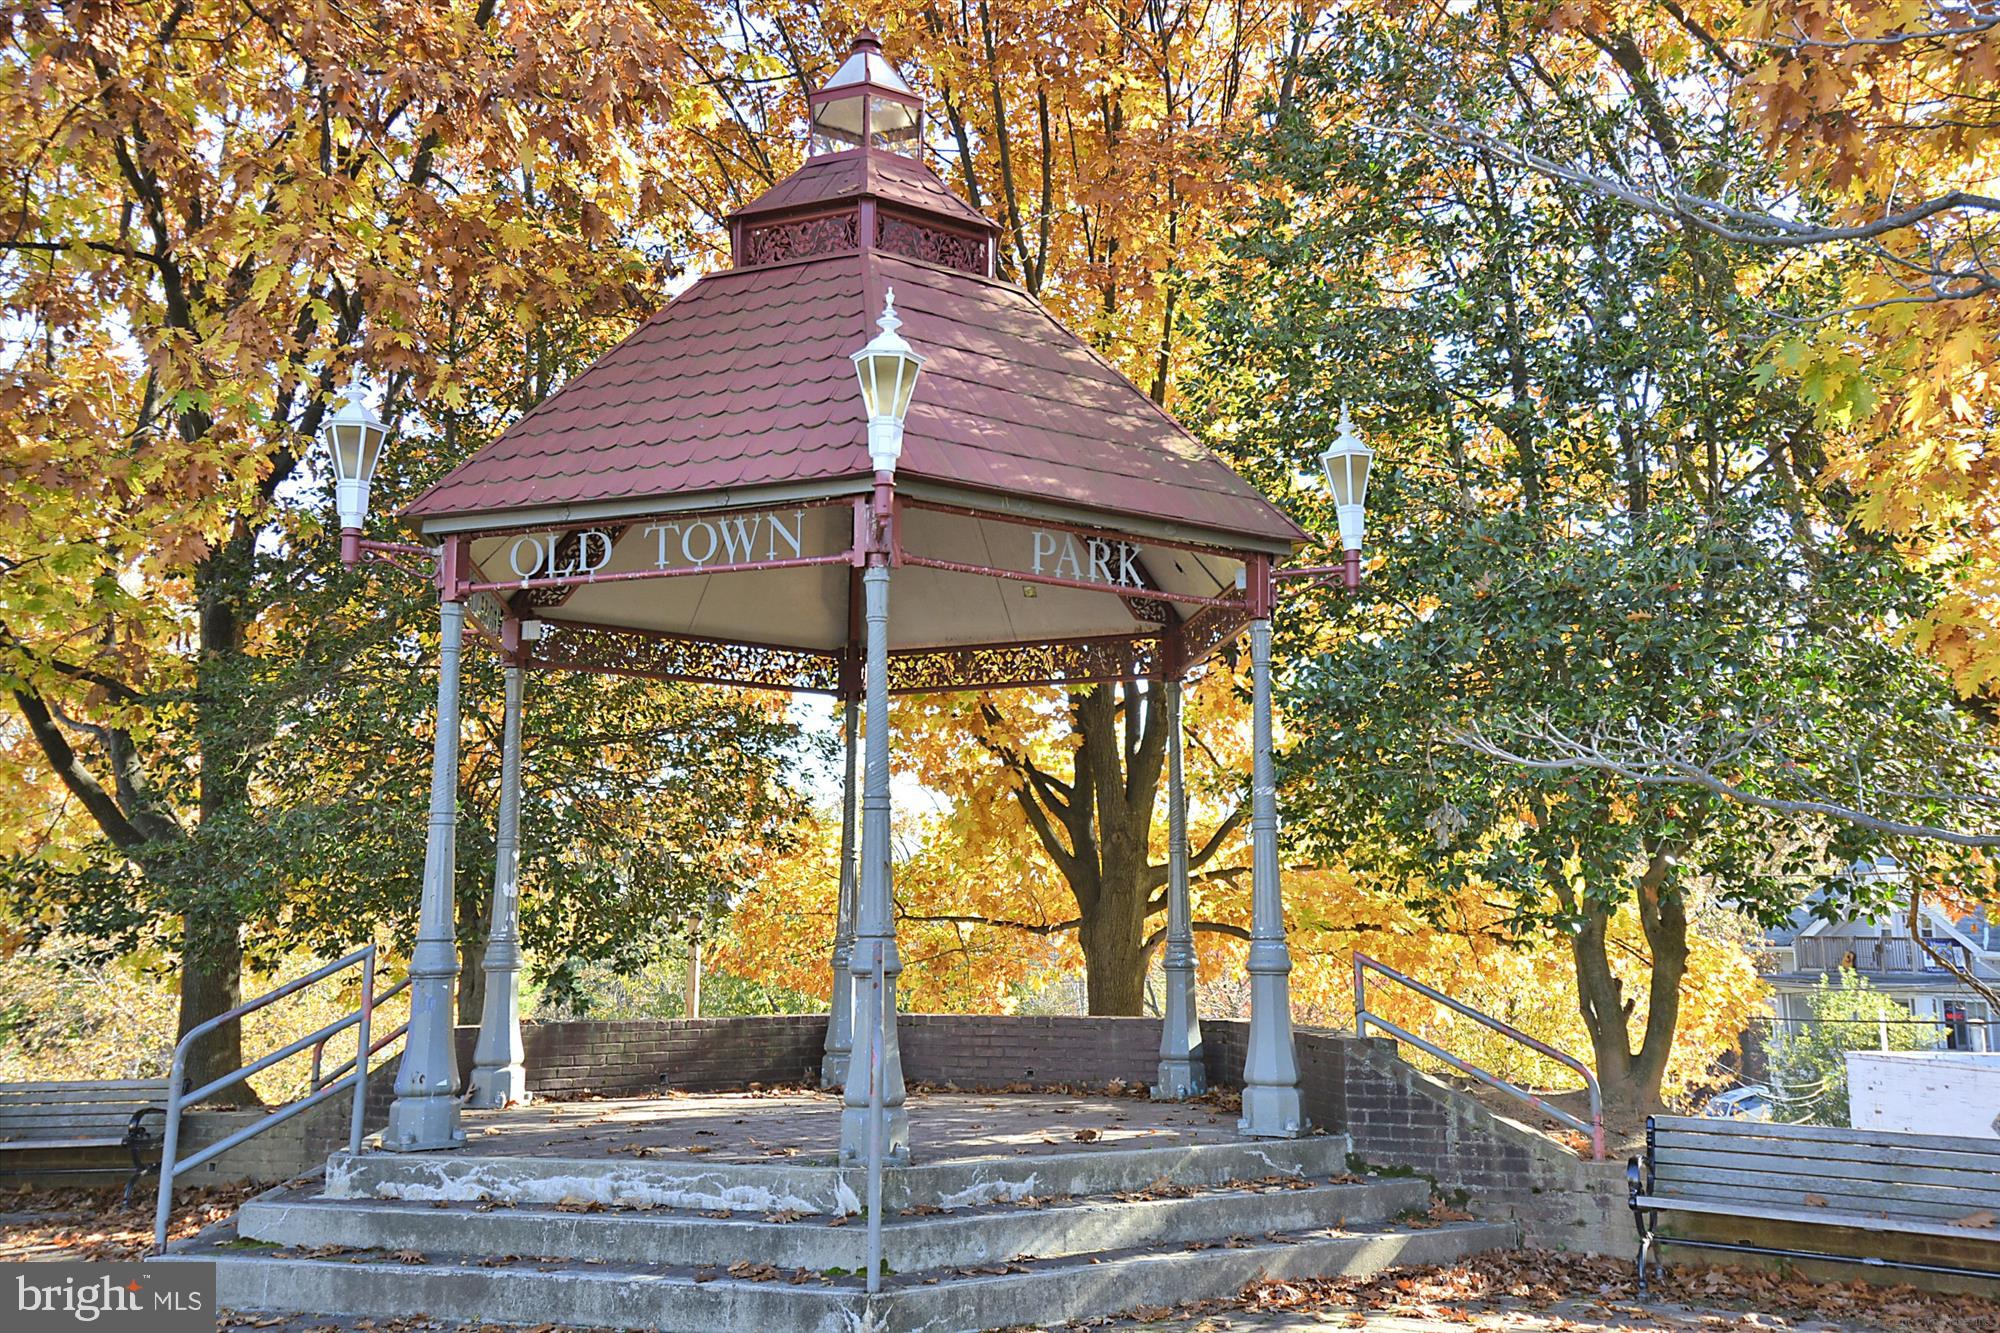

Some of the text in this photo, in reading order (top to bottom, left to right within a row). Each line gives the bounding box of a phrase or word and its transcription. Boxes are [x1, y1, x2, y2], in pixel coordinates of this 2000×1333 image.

[509, 510, 805, 581] OLD TOWN
[1031, 529, 1144, 589] PARK
